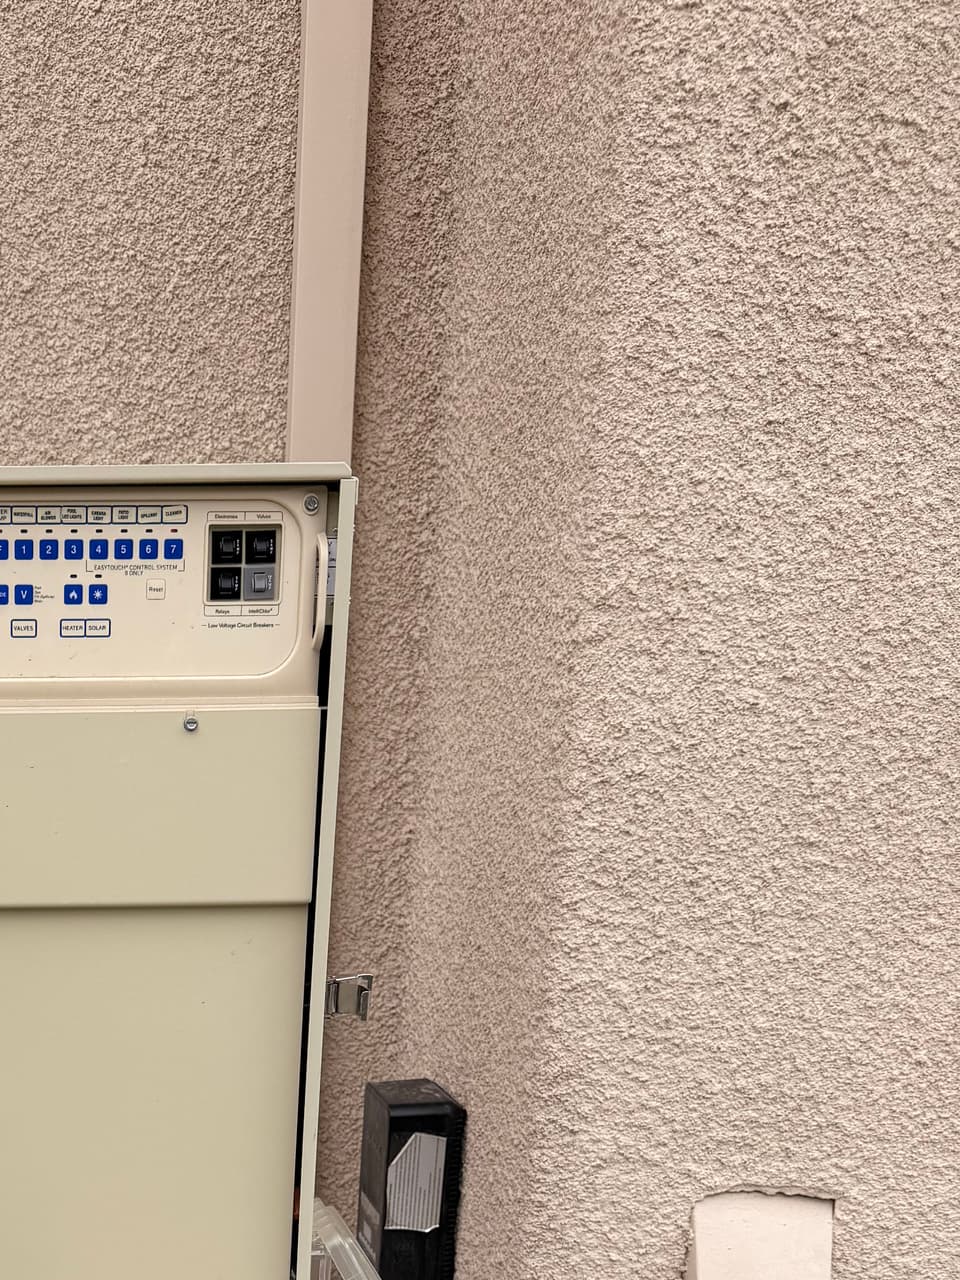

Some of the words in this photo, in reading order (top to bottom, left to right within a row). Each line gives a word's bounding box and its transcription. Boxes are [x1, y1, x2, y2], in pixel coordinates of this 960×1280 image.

[22, 545, 26, 554] 1
[46, 545, 52, 554] 2
[71, 545, 77, 554] 3
[96, 545, 101, 554] 4
[121, 545, 127, 554] 5
[146, 545, 151, 554] 6
[171, 545, 176, 554] 7
[21, 591, 27, 599] V
